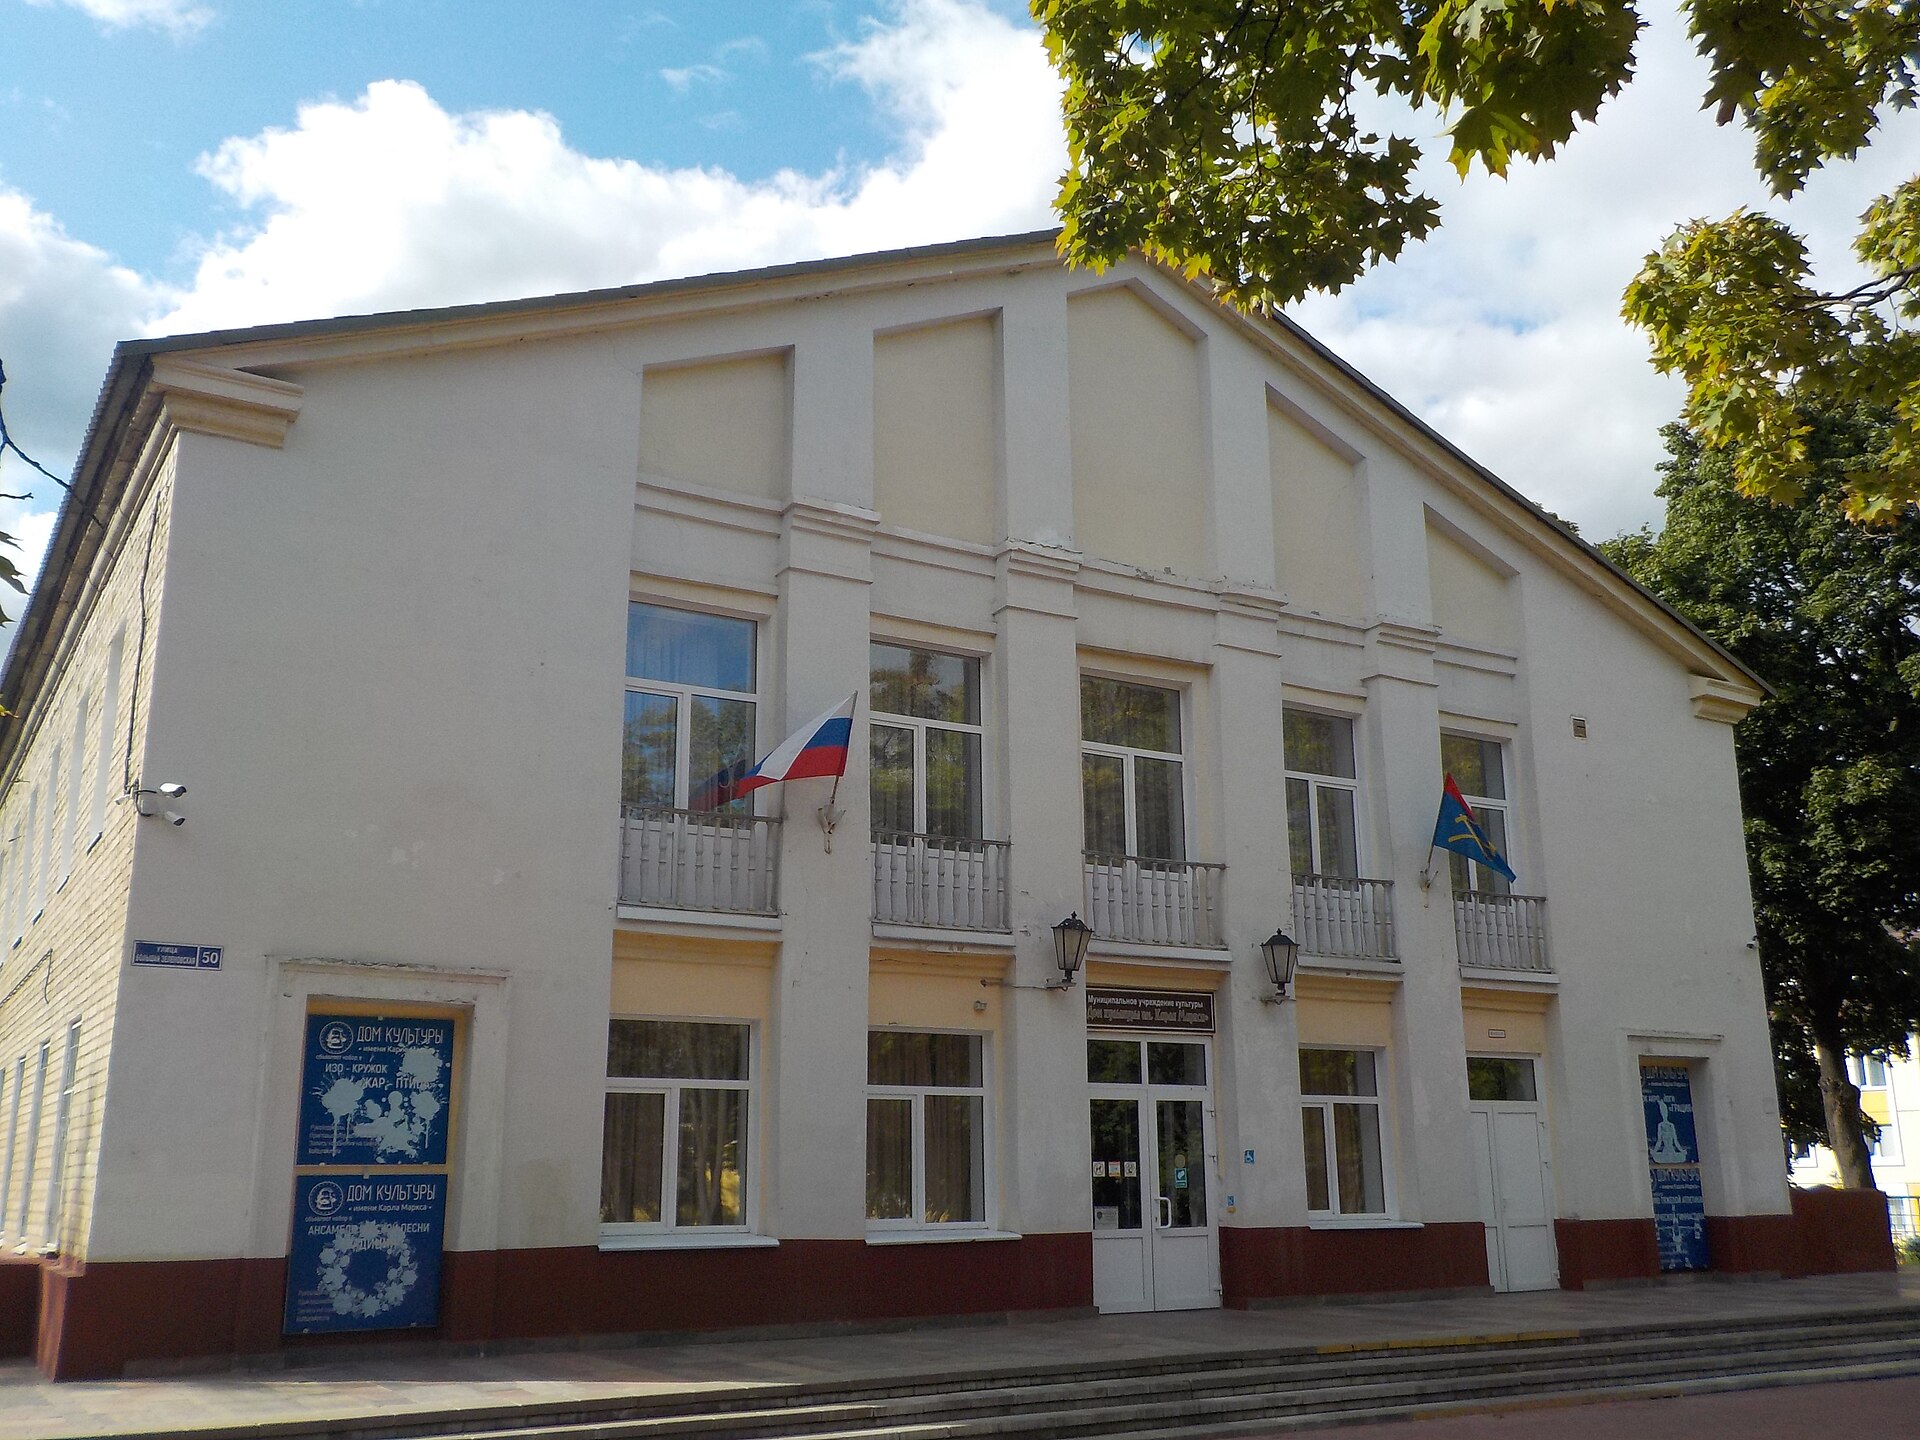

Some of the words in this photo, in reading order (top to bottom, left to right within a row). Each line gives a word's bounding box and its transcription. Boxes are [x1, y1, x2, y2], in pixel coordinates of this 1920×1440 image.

[157, 946, 178, 954] УЛИЦА
[201, 951, 219, 964] 50
[1087, 994, 1138, 1006] Муниципальное
[1138, 998, 1174, 1008] учреждение
[1175, 1001, 1204, 1010] культуры
[356, 1026, 381, 1043] ДОМ
[385, 1026, 444, 1044] КУЛЬТУРЫ
[325, 1063, 344, 1073] ИЗО
[352, 1063, 389, 1074] КРУЖОК
[346, 1184, 372, 1202] ДОМ
[376, 1184, 436, 1202] КУЛЬТУРЫ
[378, 1204, 400, 1213] Карла
[400, 1203, 427, 1212] Маркса
